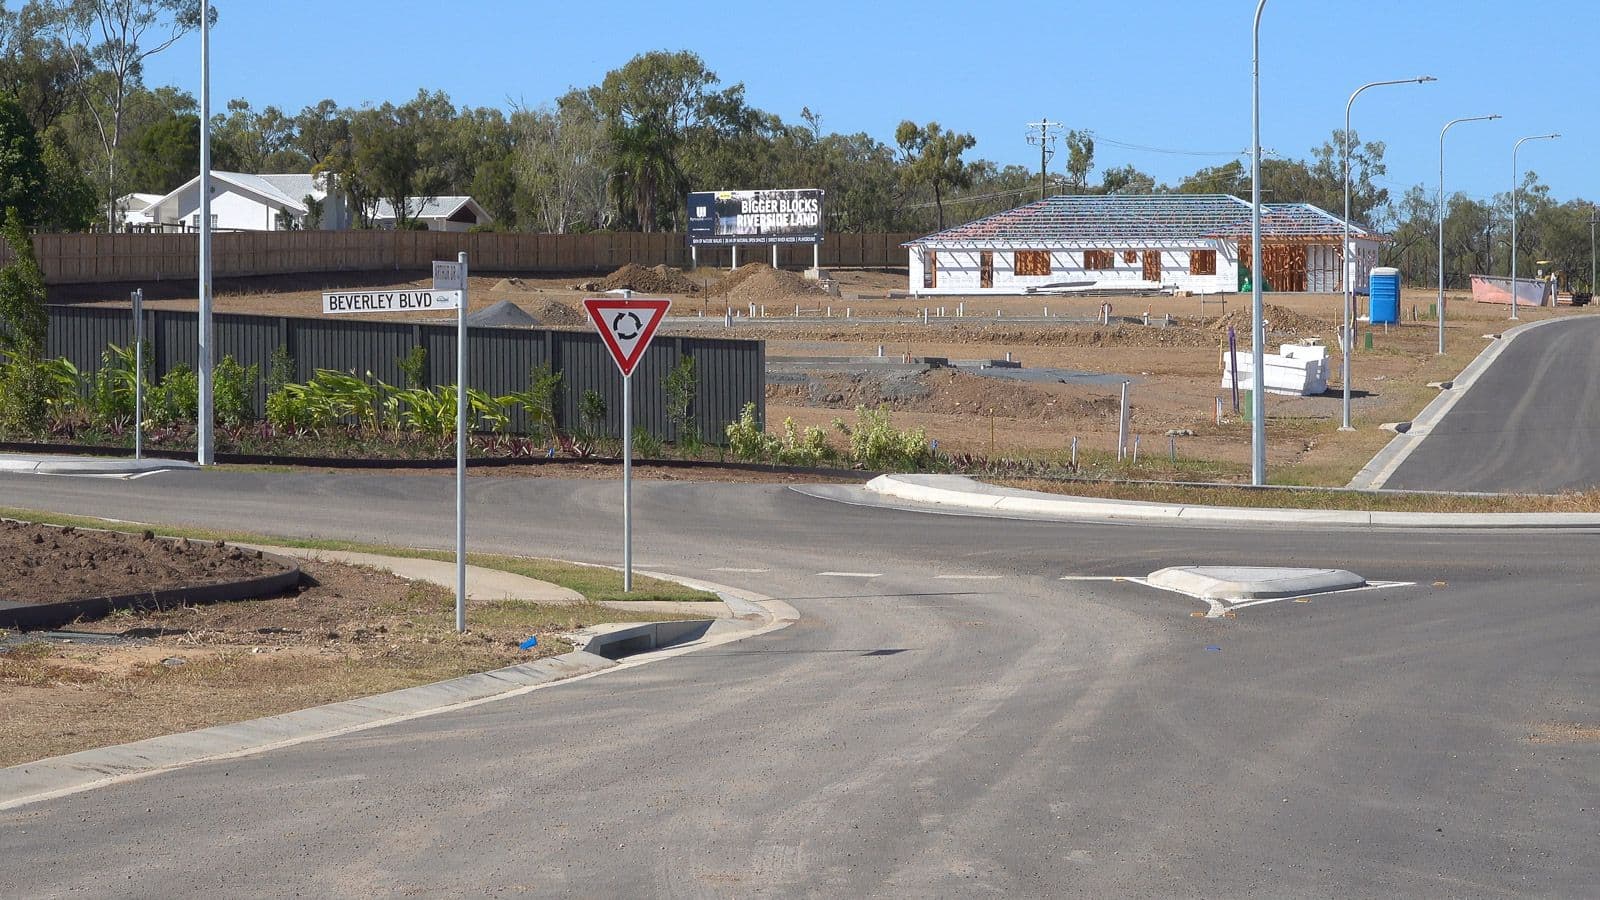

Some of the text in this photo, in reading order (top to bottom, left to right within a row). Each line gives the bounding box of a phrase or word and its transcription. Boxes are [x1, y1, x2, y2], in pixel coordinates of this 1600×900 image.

[741, 198, 818, 213] BIGGER BLOCKS
[736, 212, 818, 227] RIVERSIDE LAND
[329, 293, 432, 310] BEVERLEY BLVD
